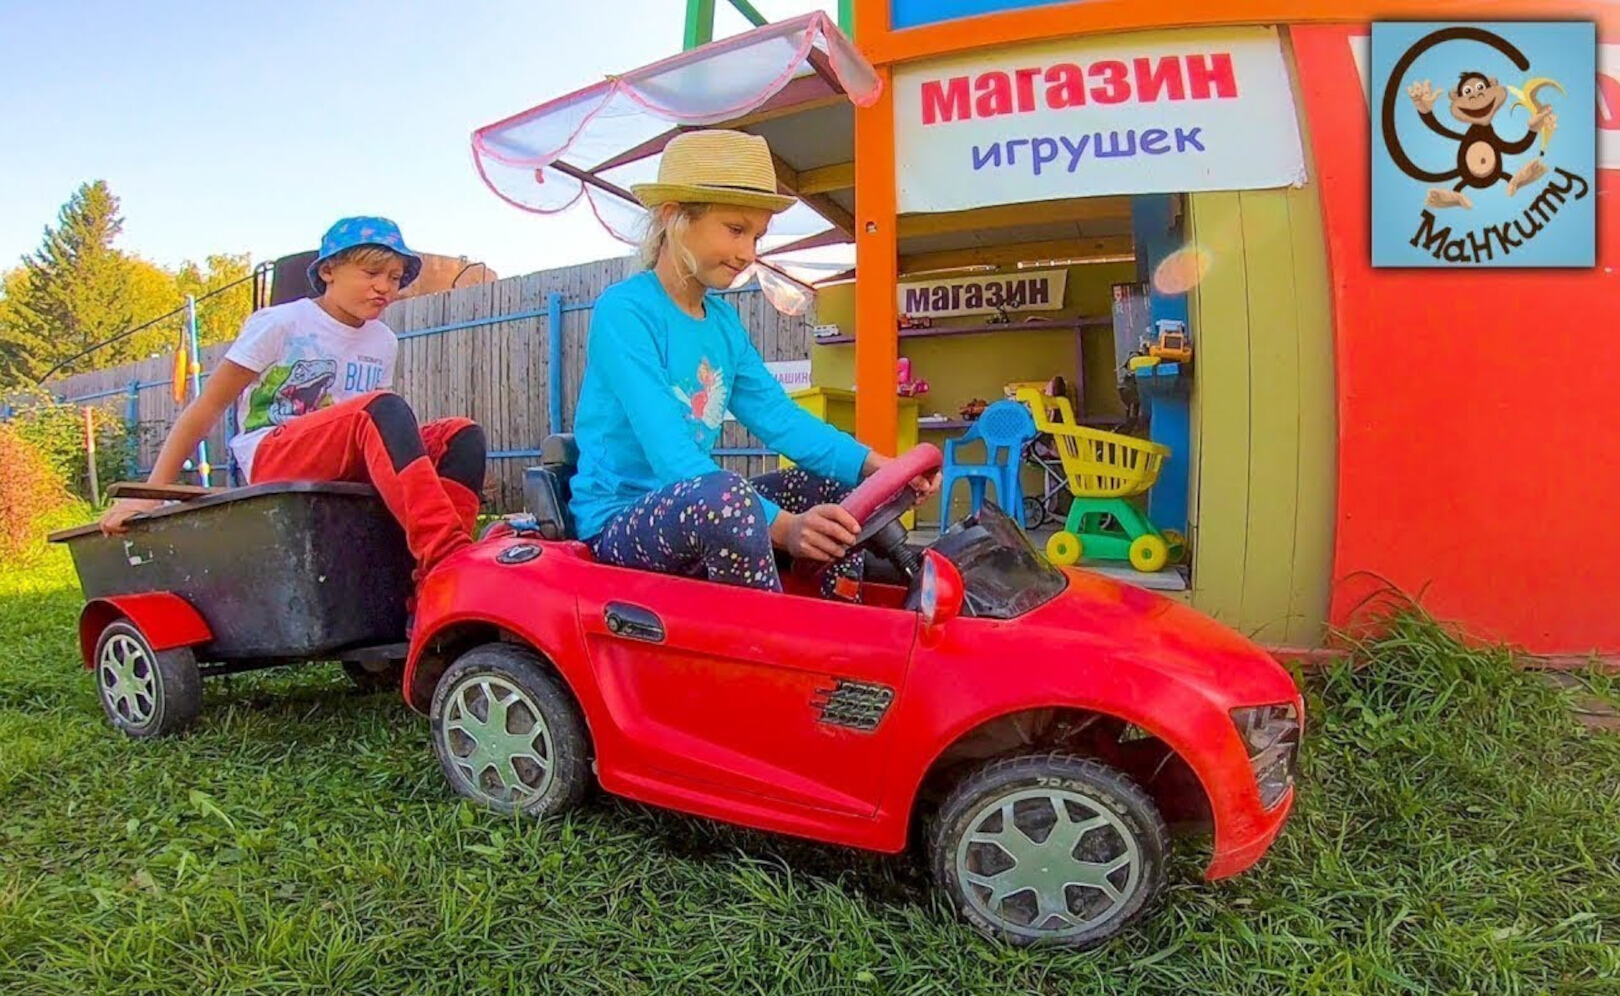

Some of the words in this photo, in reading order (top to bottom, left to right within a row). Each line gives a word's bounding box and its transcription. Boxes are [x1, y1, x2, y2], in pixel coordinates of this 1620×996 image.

[921, 53, 1238, 125] магазин
[972, 127, 1205, 175] игрушек
[905, 278, 1049, 313] магазин
